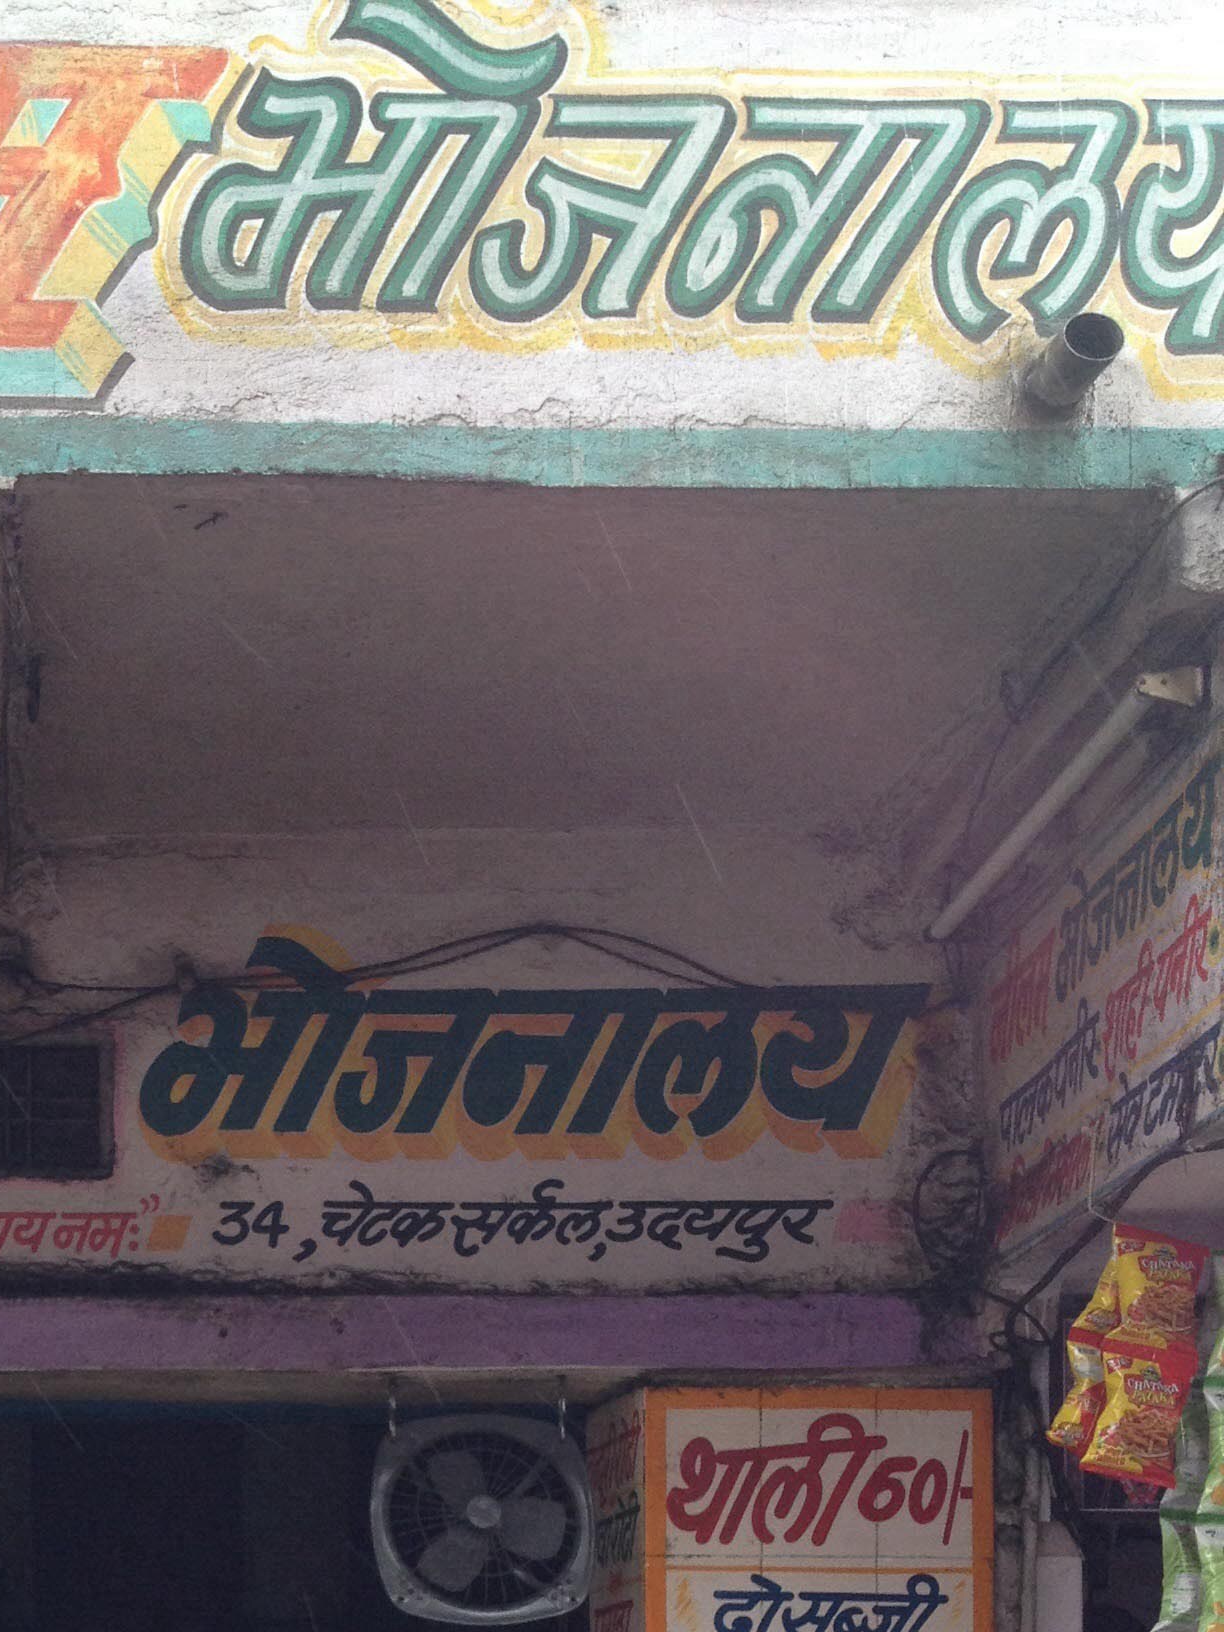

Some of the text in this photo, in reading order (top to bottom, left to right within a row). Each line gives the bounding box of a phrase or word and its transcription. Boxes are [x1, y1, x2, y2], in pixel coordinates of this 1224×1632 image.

[139, 935, 926, 1138] भोजनालय
[319, 1179, 454, 1246] चेटक
[604, 1199, 834, 1263] उदयपुर
[667, 1413, 973, 1547] थाली 60/-
